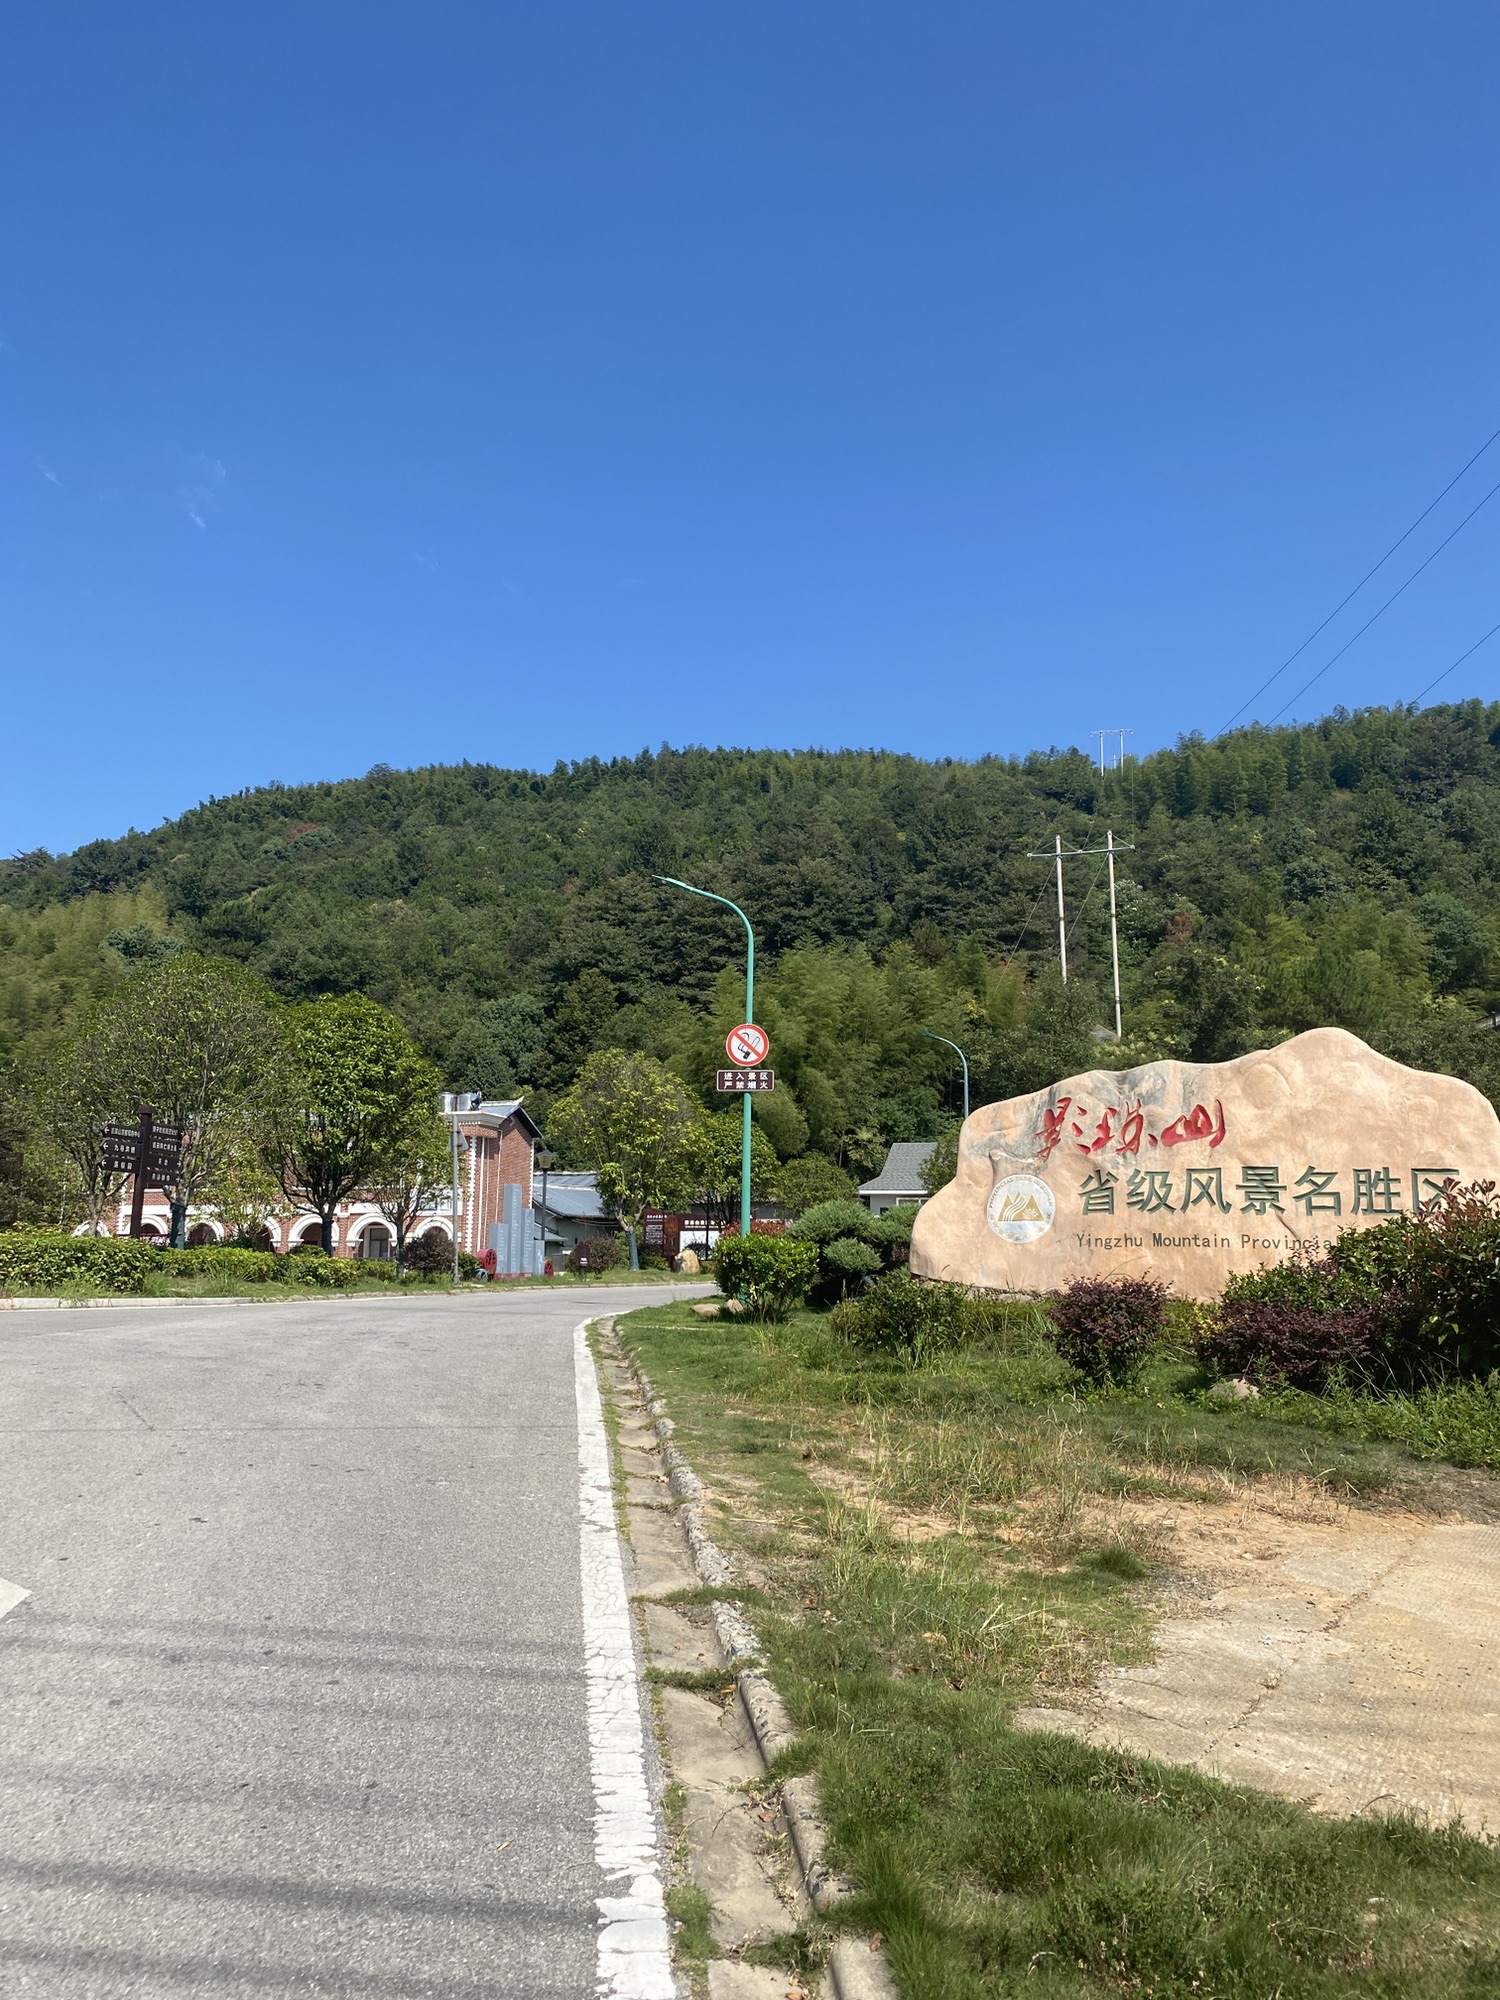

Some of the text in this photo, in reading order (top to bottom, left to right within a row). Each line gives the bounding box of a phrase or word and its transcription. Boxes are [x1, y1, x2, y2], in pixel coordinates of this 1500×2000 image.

[724, 1072, 768, 1080] 进入景区
[724, 1081, 768, 1089] 严禁烟火
[1078, 1165, 1460, 1216] 省级风景名胜区
[1077, 1233, 1143, 1250] Yingzhu
[1153, 1232, 1230, 1248] Mountain
